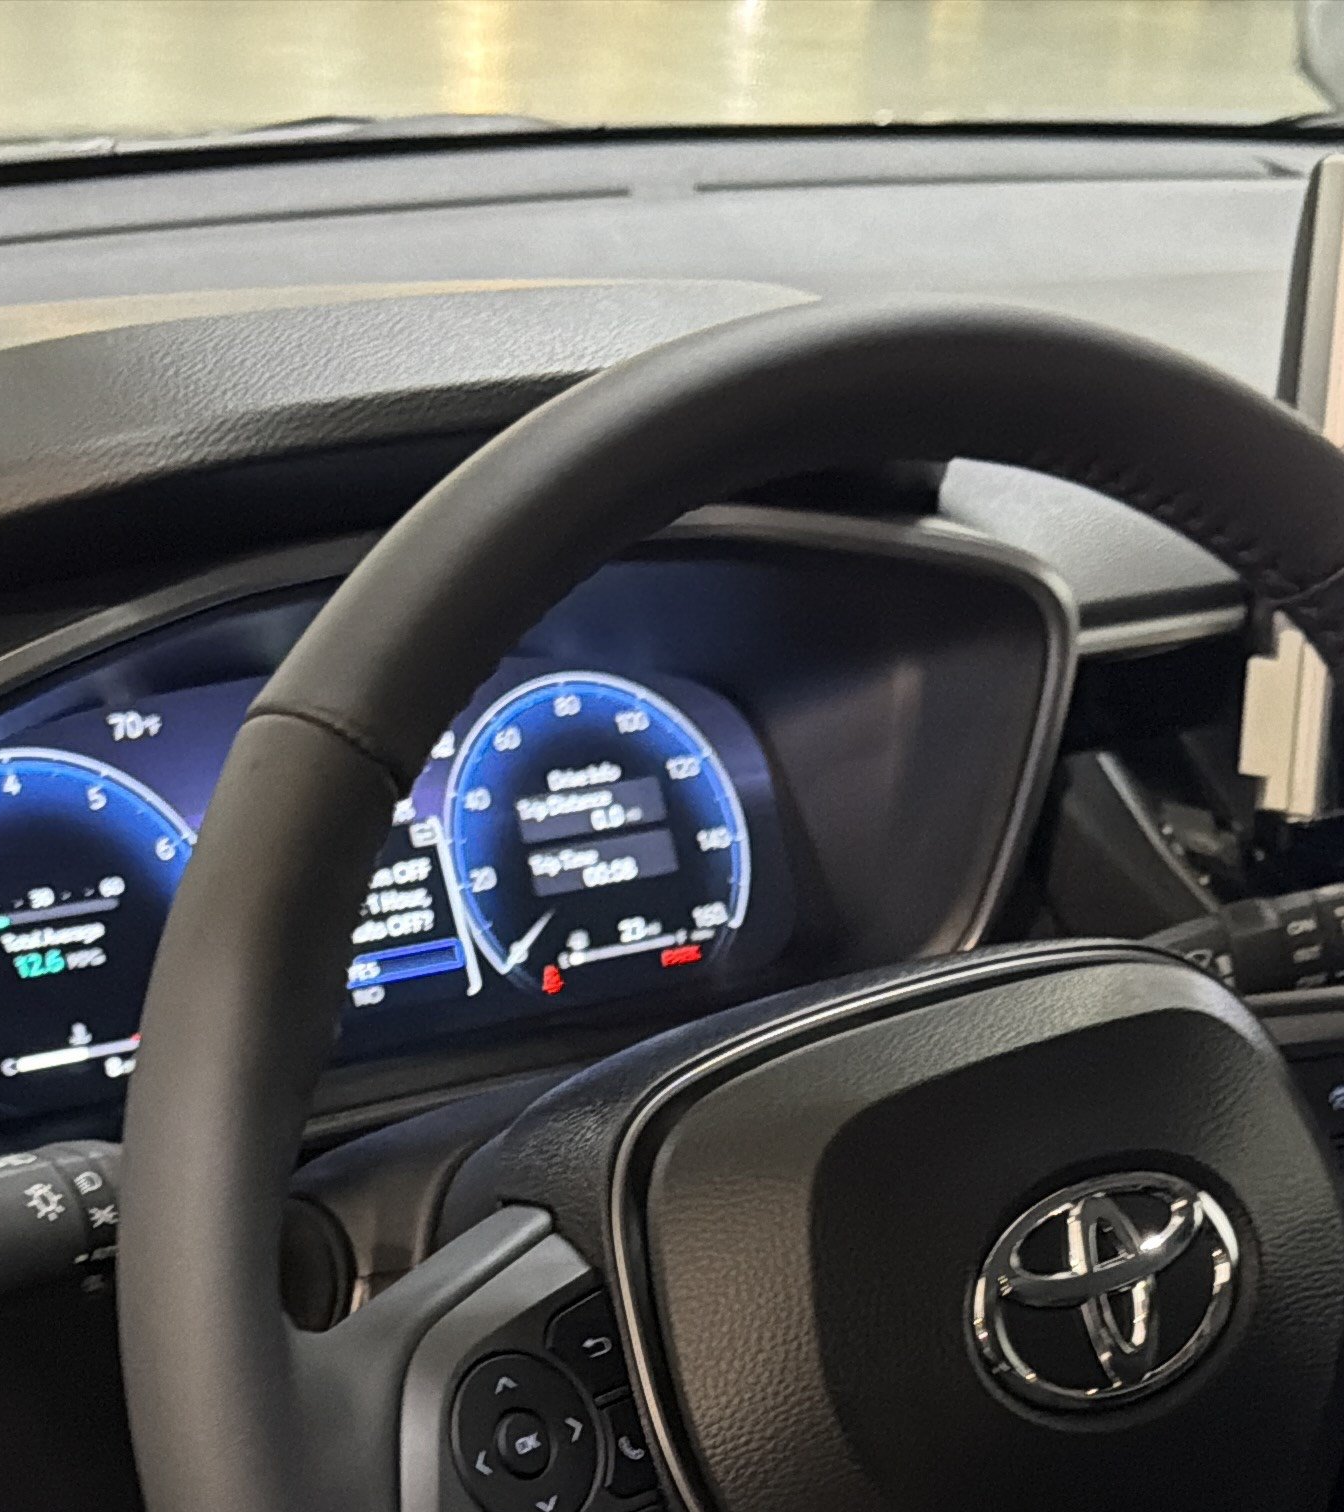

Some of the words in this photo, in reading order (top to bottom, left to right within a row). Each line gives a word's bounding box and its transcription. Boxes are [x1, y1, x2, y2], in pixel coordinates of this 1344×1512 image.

[2, 774, 22, 796] 4
[87, 786, 108, 811] 5
[155, 838, 177, 862] 6
